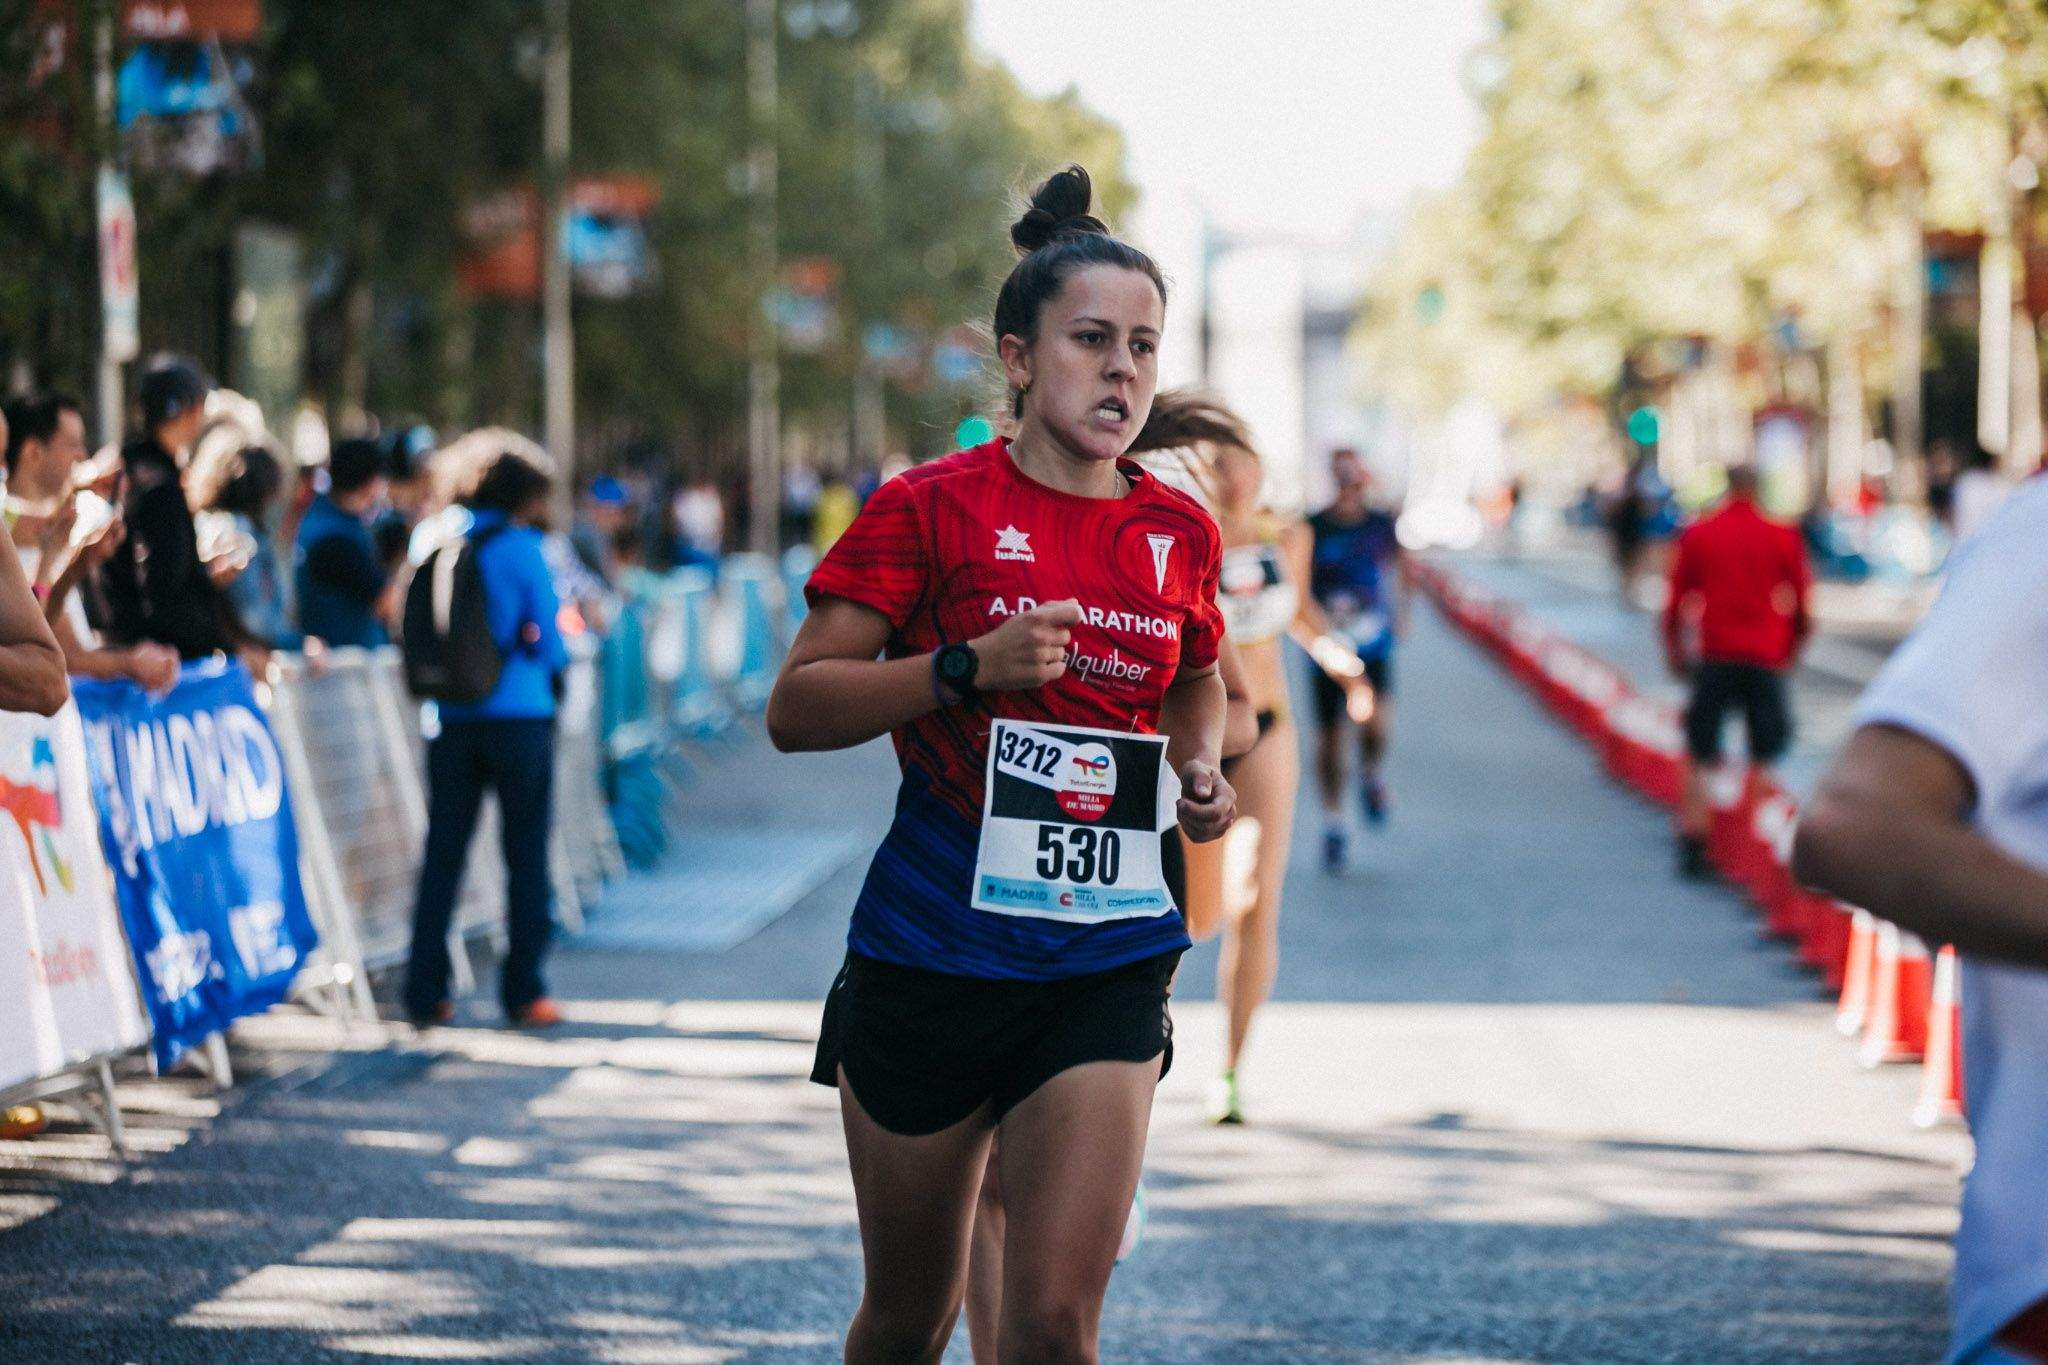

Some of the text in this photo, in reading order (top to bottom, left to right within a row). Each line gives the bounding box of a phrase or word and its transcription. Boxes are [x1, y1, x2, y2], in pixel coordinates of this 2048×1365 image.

[994, 549, 1036, 563] luanvi
[1077, 603, 1178, 641] ARATHON
[1001, 731, 1062, 778] 3212
[1036, 824, 1121, 886] 530
[1000, 886, 1048, 902] MADRID
